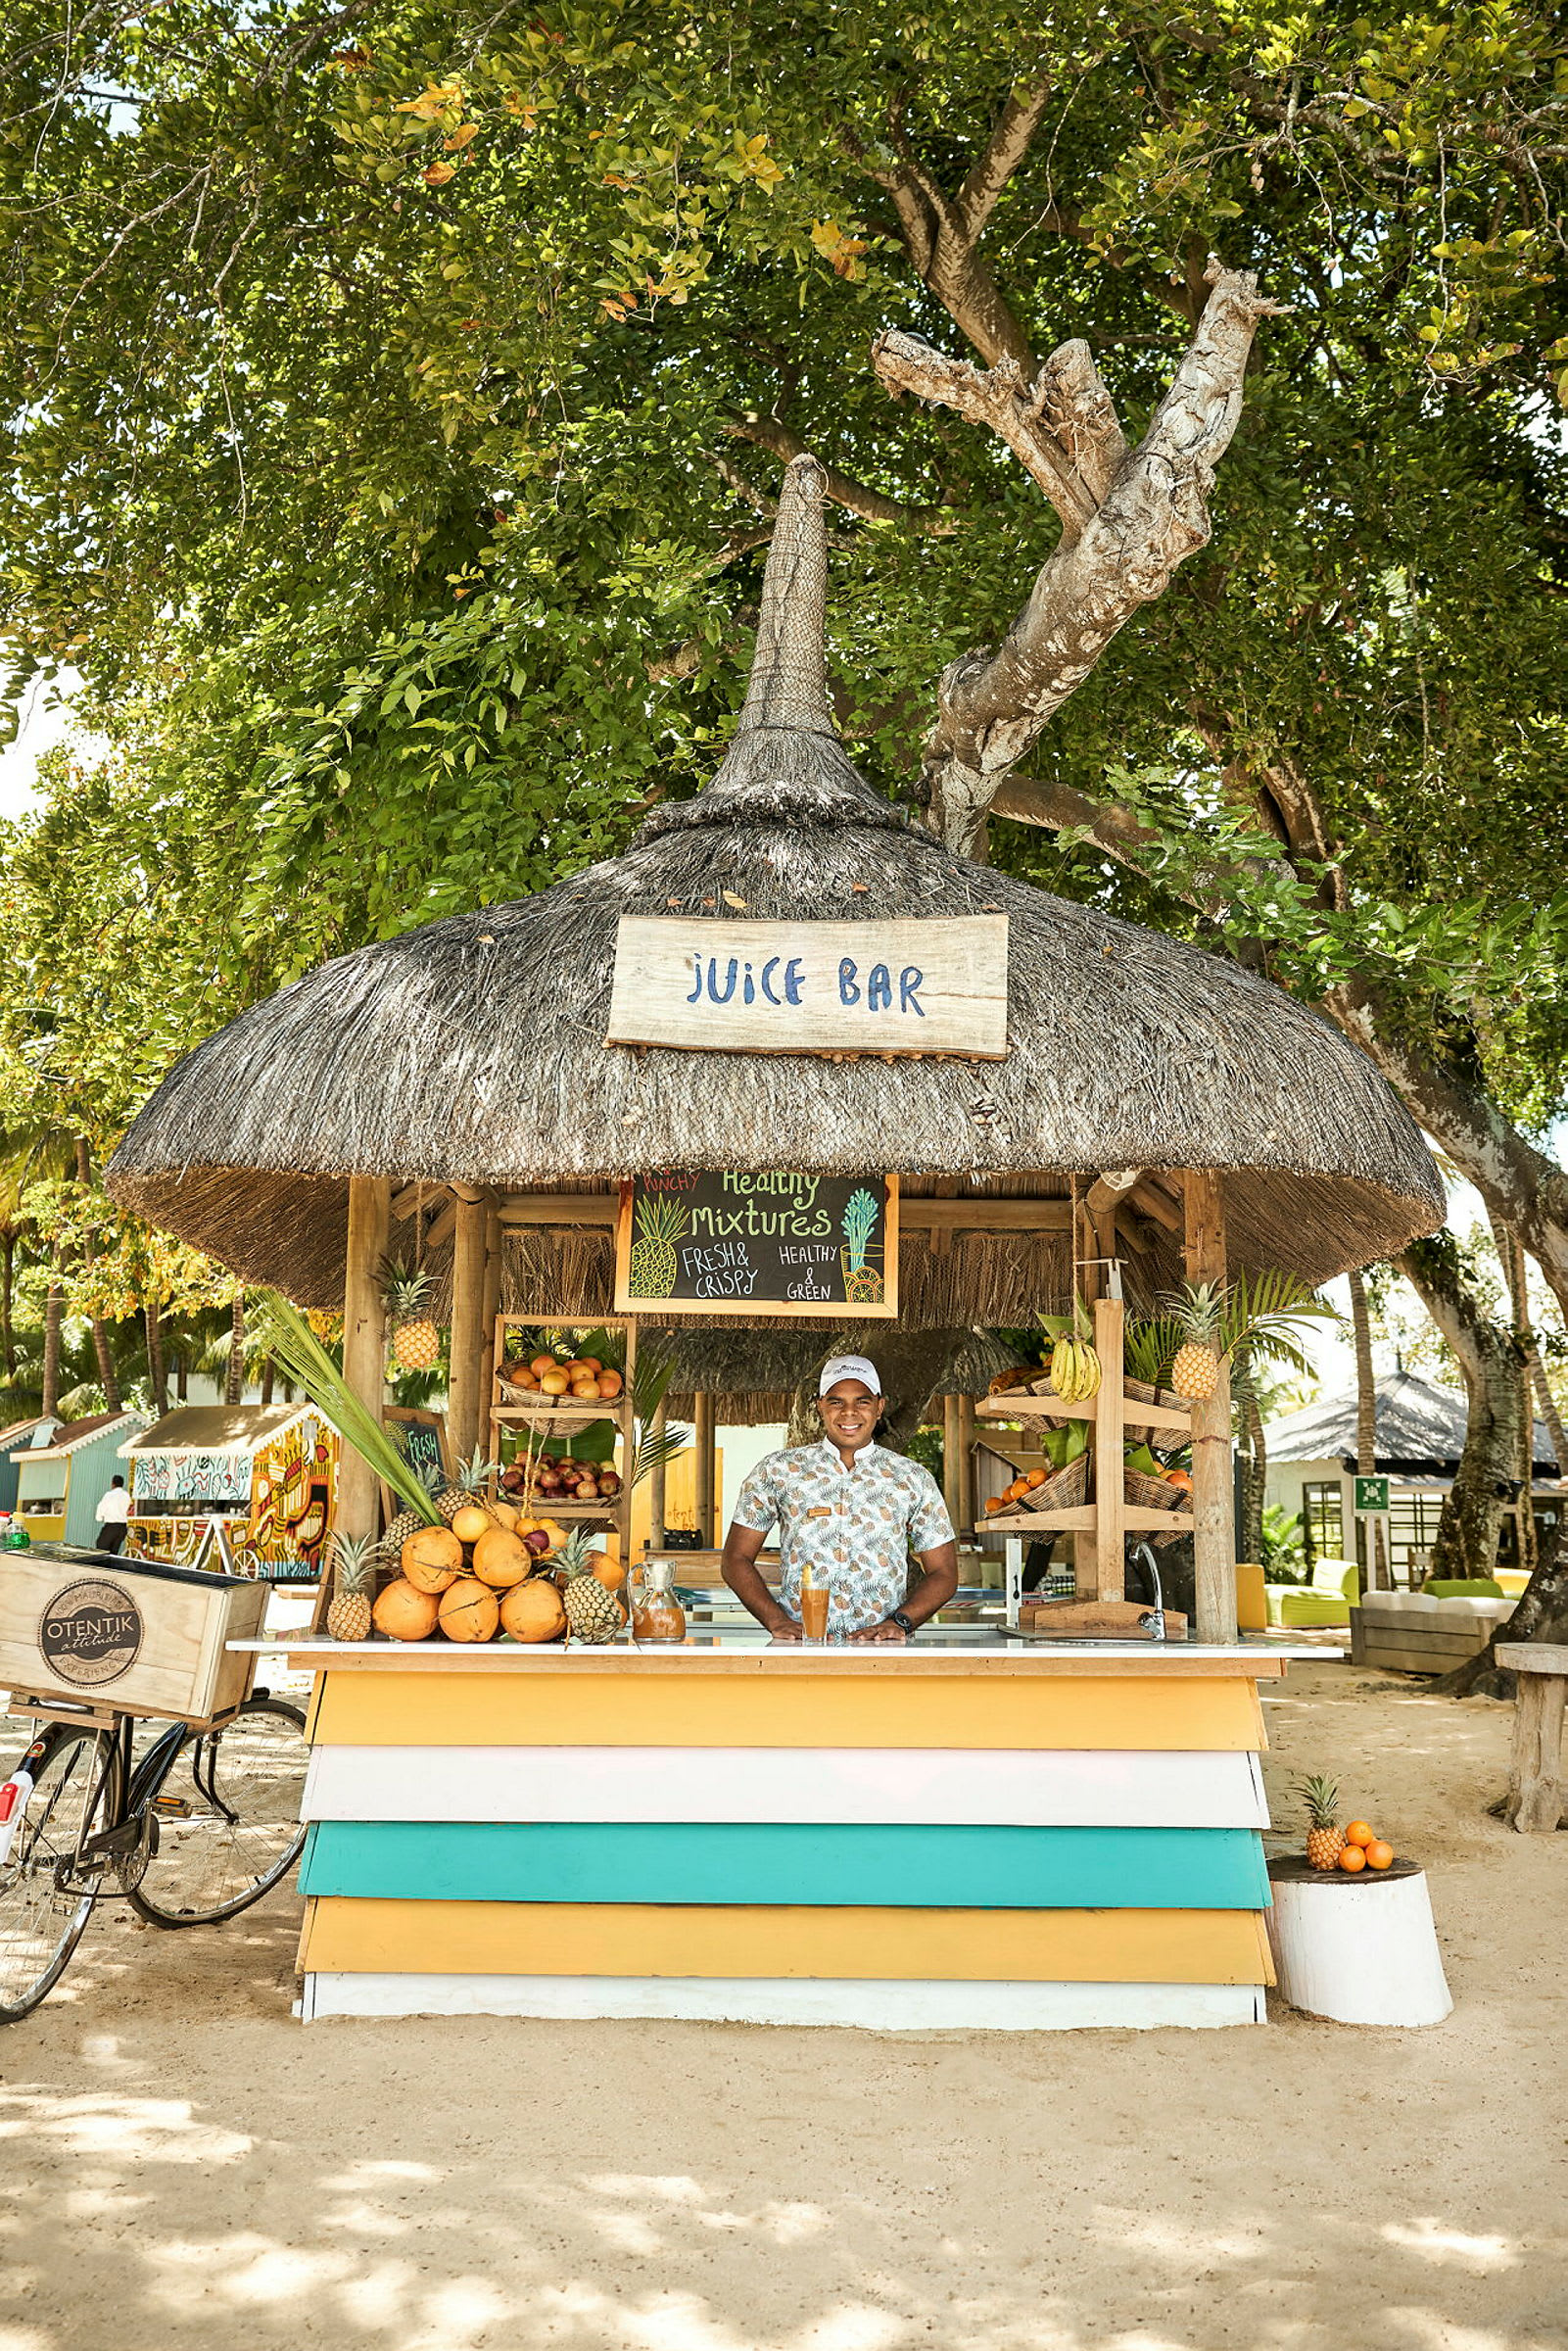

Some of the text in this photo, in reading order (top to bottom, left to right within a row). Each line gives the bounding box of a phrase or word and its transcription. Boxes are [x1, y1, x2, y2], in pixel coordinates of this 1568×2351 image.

[838, 957, 926, 1017] BAR
[723, 1170, 821, 1211] Healthy
[691, 1198, 832, 1236] Mixtures
[682, 1241, 735, 1277] FRESH
[779, 1244, 837, 1265] HEALTHY
[805, 1267, 814, 1285] &
[786, 1281, 831, 1301] GREEN
[407, 1430, 439, 1463] FRESH
[47, 1615, 134, 1639] OTENTIK
[61, 1630, 122, 1652] attitude
